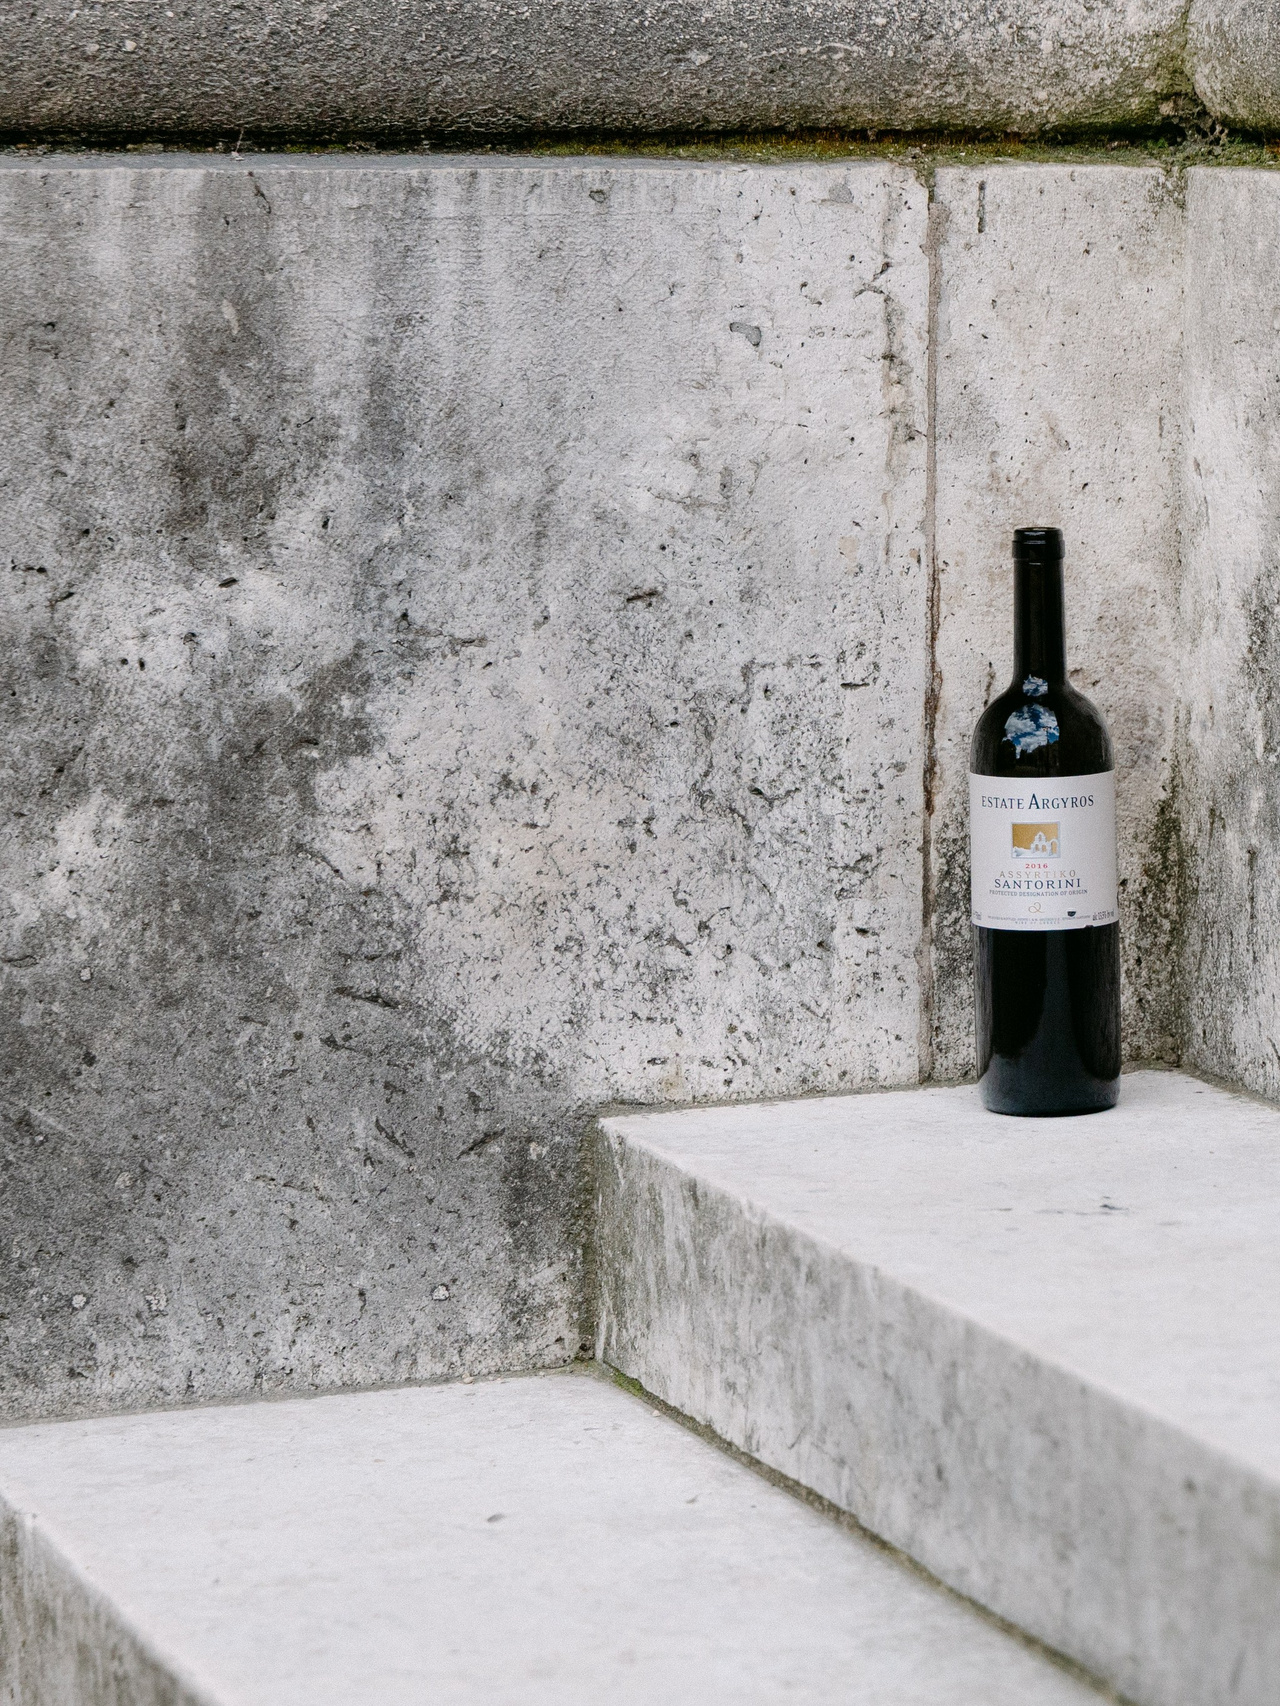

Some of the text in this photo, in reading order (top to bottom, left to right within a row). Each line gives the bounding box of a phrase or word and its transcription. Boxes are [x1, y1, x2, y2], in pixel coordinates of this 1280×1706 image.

[981, 793, 1094, 810] ESTATE ARGYROS
[999, 869, 1076, 879] ASSYRTIKO
[994, 878, 1081, 890] SANTORINI
[989, 889, 1018, 897] PROTECTED
